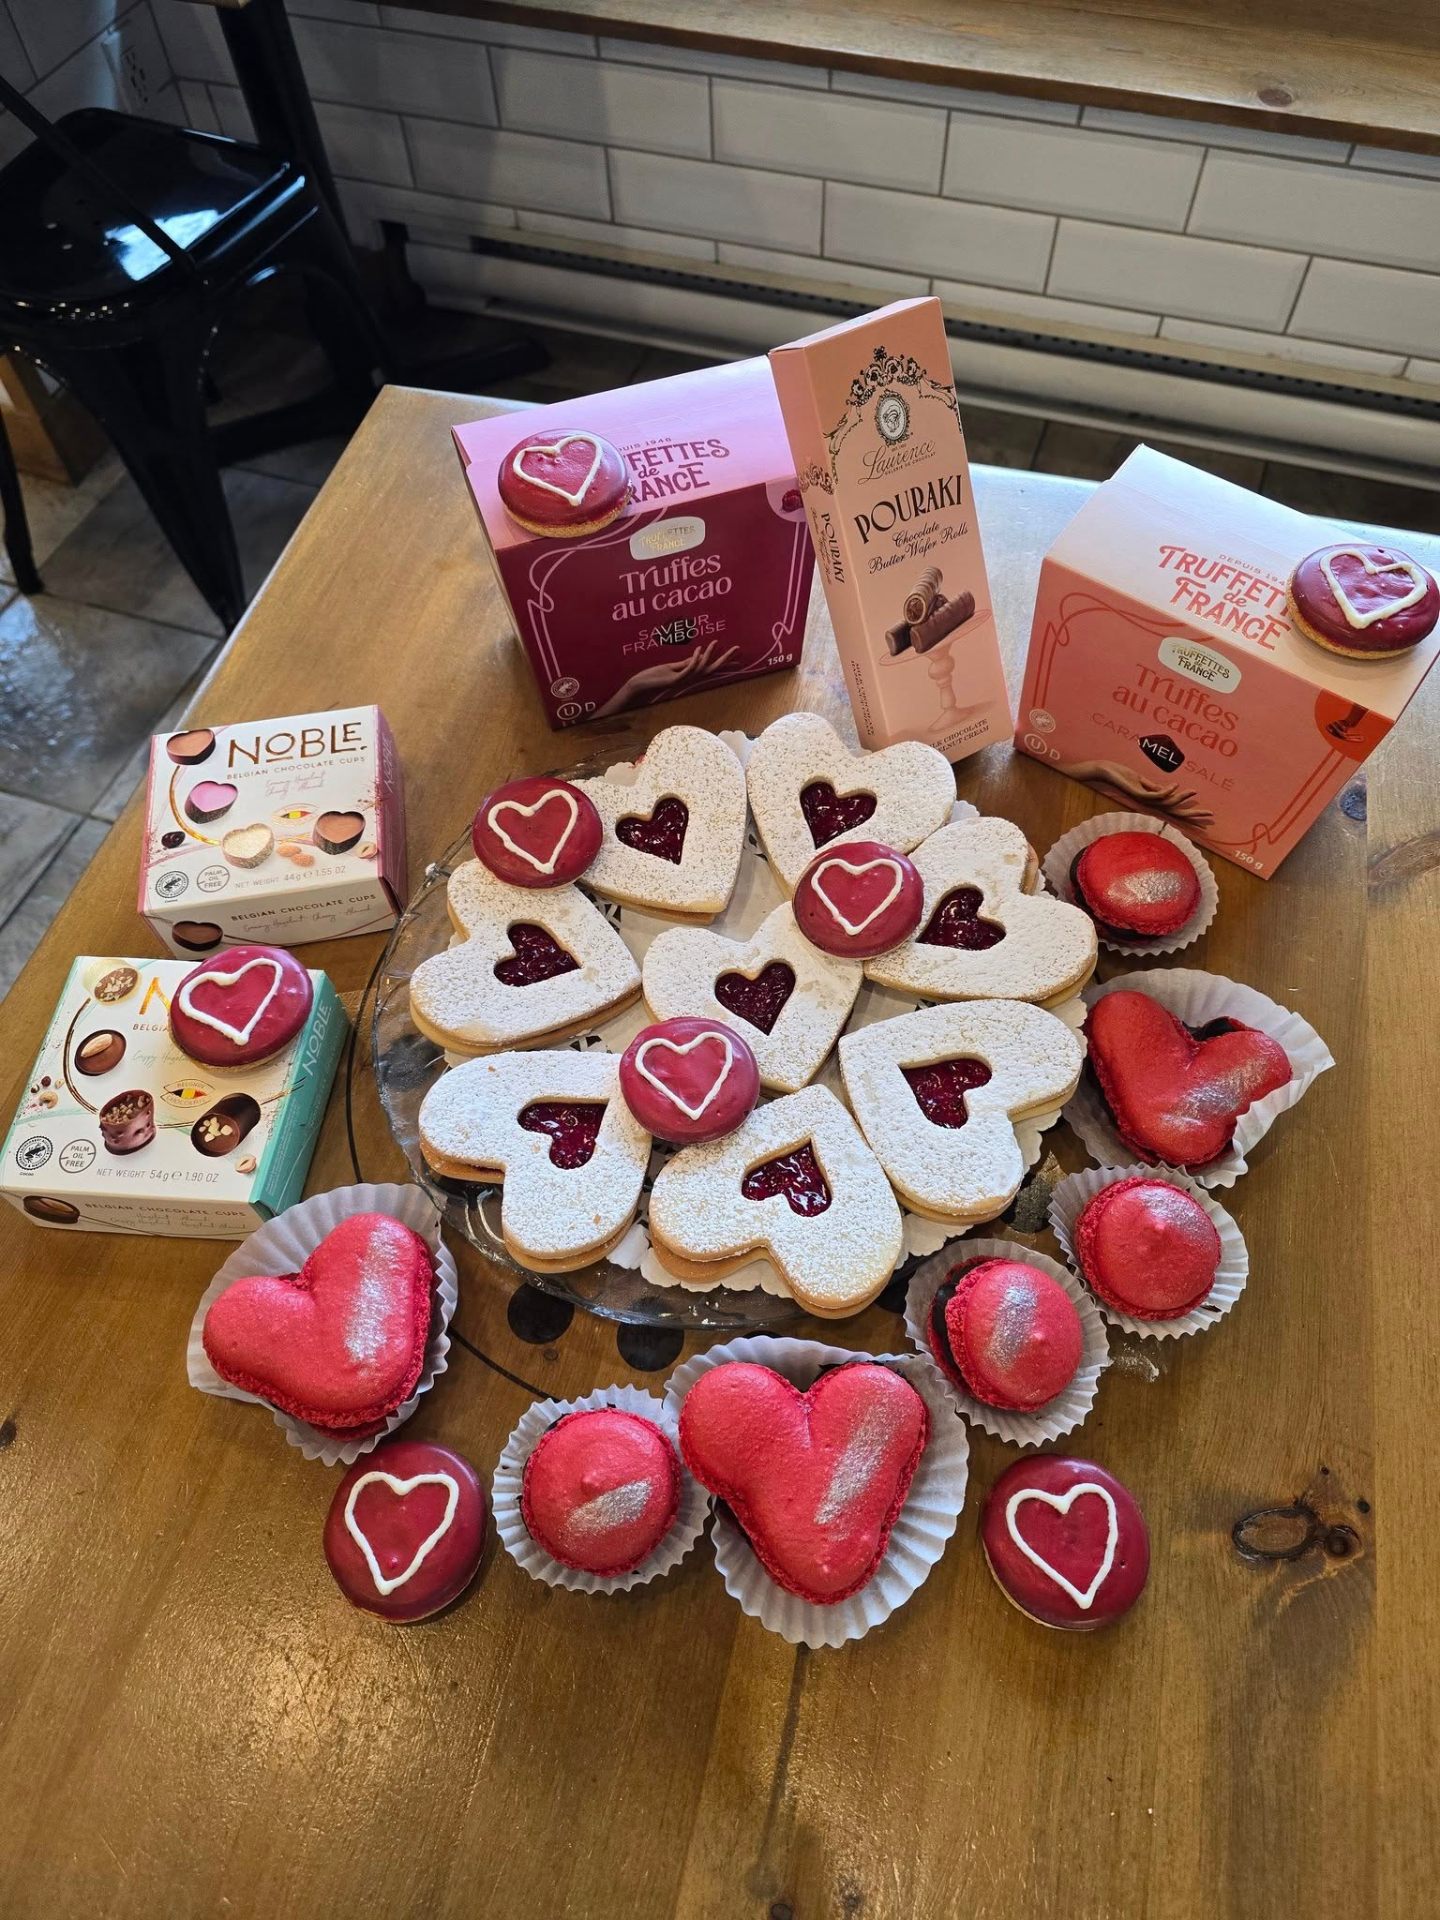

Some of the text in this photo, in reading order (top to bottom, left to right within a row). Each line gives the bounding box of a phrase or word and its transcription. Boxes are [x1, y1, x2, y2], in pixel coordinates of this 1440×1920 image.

[623, 439, 730, 471] FETTES
[857, 440, 936, 485] Laurence
[626, 462, 710, 505] RANCE
[638, 464, 660, 479] de
[853, 474, 962, 545] POURAKI
[821, 512, 845, 584] POURAKI
[868, 522, 969, 574] Butter Wafer Rolls
[892, 521, 940, 547] Chocolate
[619, 554, 721, 594] Truffes
[1158, 545, 1289, 616] TRUFFET
[612, 576, 732, 621] au cacao
[1223, 588, 1247, 607] de
[638, 614, 709, 640] SAVEUR
[1169, 576, 1292, 651] FRANCE
[622, 620, 727, 656] FRAMBOISE
[767, 654, 785, 666] 150
[1171, 646, 1230, 679] TRUFFETTES
[1178, 656, 1218, 682] FRANCE
[1136, 663, 1239, 732] Truffes
[943, 719, 988, 743] CHOCOLATE
[1112, 686, 1239, 758] au cacao
[1091, 712, 1179, 766] CARAMEL
[226, 755, 366, 780] BELGIAN CHOCOLATE CUPS
[1184, 760, 1235, 792] SALÉ
[1234, 850, 1254, 864] 150
[204, 869, 223, 877] PALM
[204, 881, 222, 889] FREE
[253, 877, 279, 886] WEIGHT
[230, 894, 377, 922] BELGIAN CHOCOLATE CUPS
[132, 1023, 168, 1031] BELGI
[65, 1159, 85, 1167] FREE
[96, 1168, 113, 1176] NET
[115, 1169, 145, 1178] WEIGHT
[149, 1169, 169, 1181] 54g
[185, 1171, 203, 1182] 1.90
[205, 1173, 220, 1183] OZ
[84, 1202, 134, 1210] BELGIAN
[139, 1206, 209, 1215] CHOCOLATE
